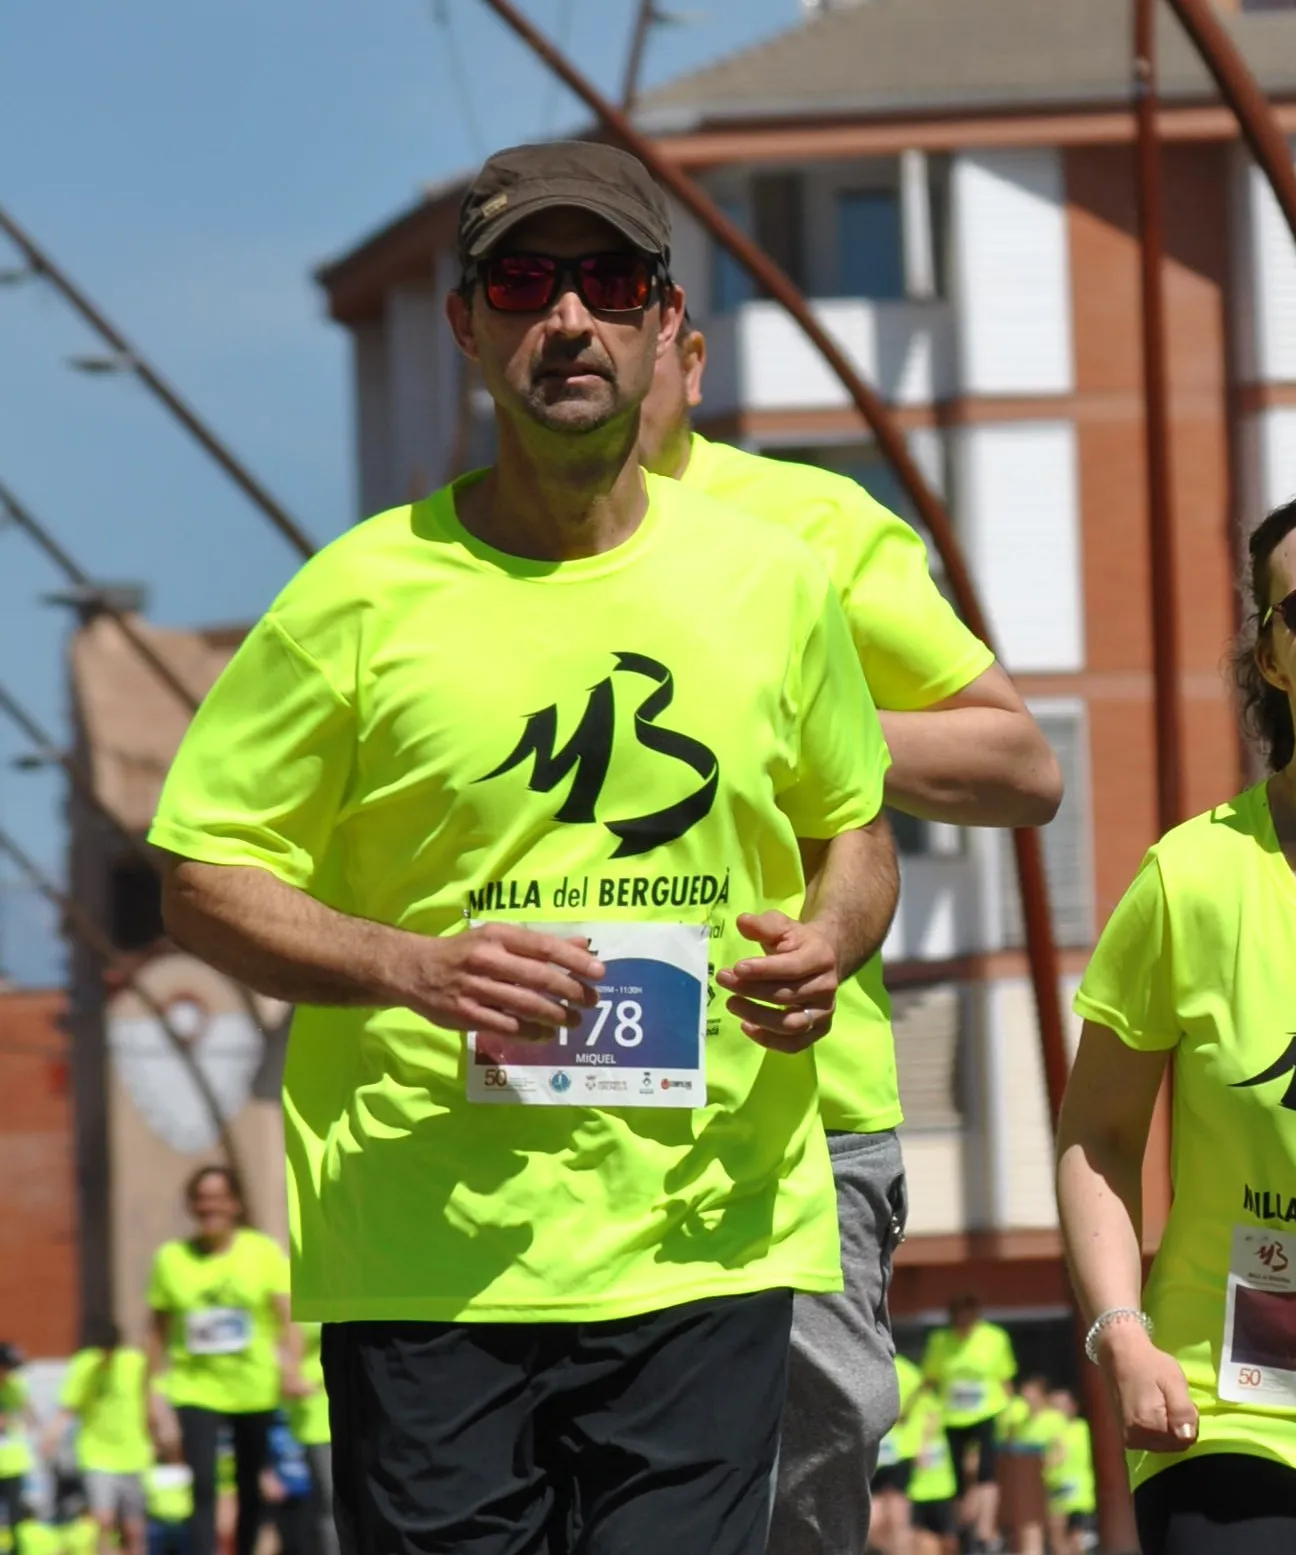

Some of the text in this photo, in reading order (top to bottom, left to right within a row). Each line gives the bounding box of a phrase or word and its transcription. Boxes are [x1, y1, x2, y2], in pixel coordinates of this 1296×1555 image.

[553, 877, 588, 907] del
[575, 1053, 617, 1066] MIQUEL
[1237, 1367, 1262, 1388] 50
